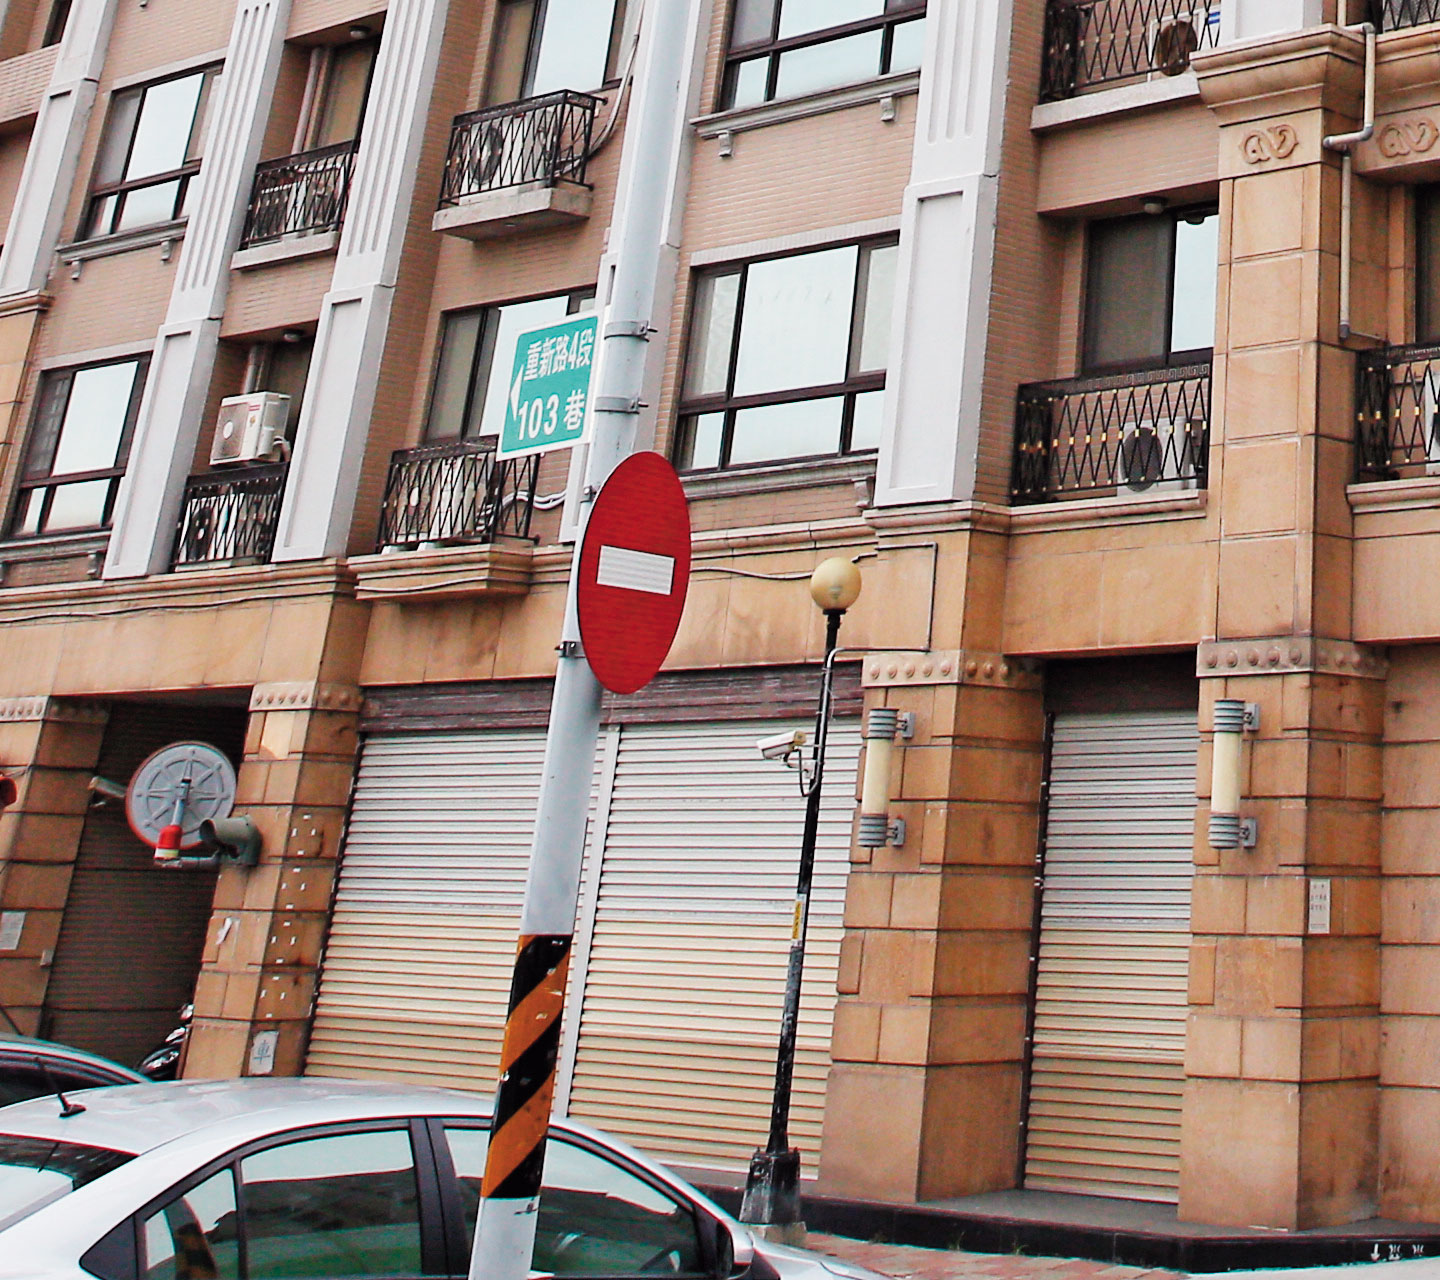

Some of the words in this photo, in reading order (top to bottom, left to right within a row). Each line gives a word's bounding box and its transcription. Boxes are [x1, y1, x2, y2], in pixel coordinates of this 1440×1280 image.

[523, 328, 594, 381] 重新路4段
[518, 393, 559, 441] 103
[563, 388, 585, 431] 巷
